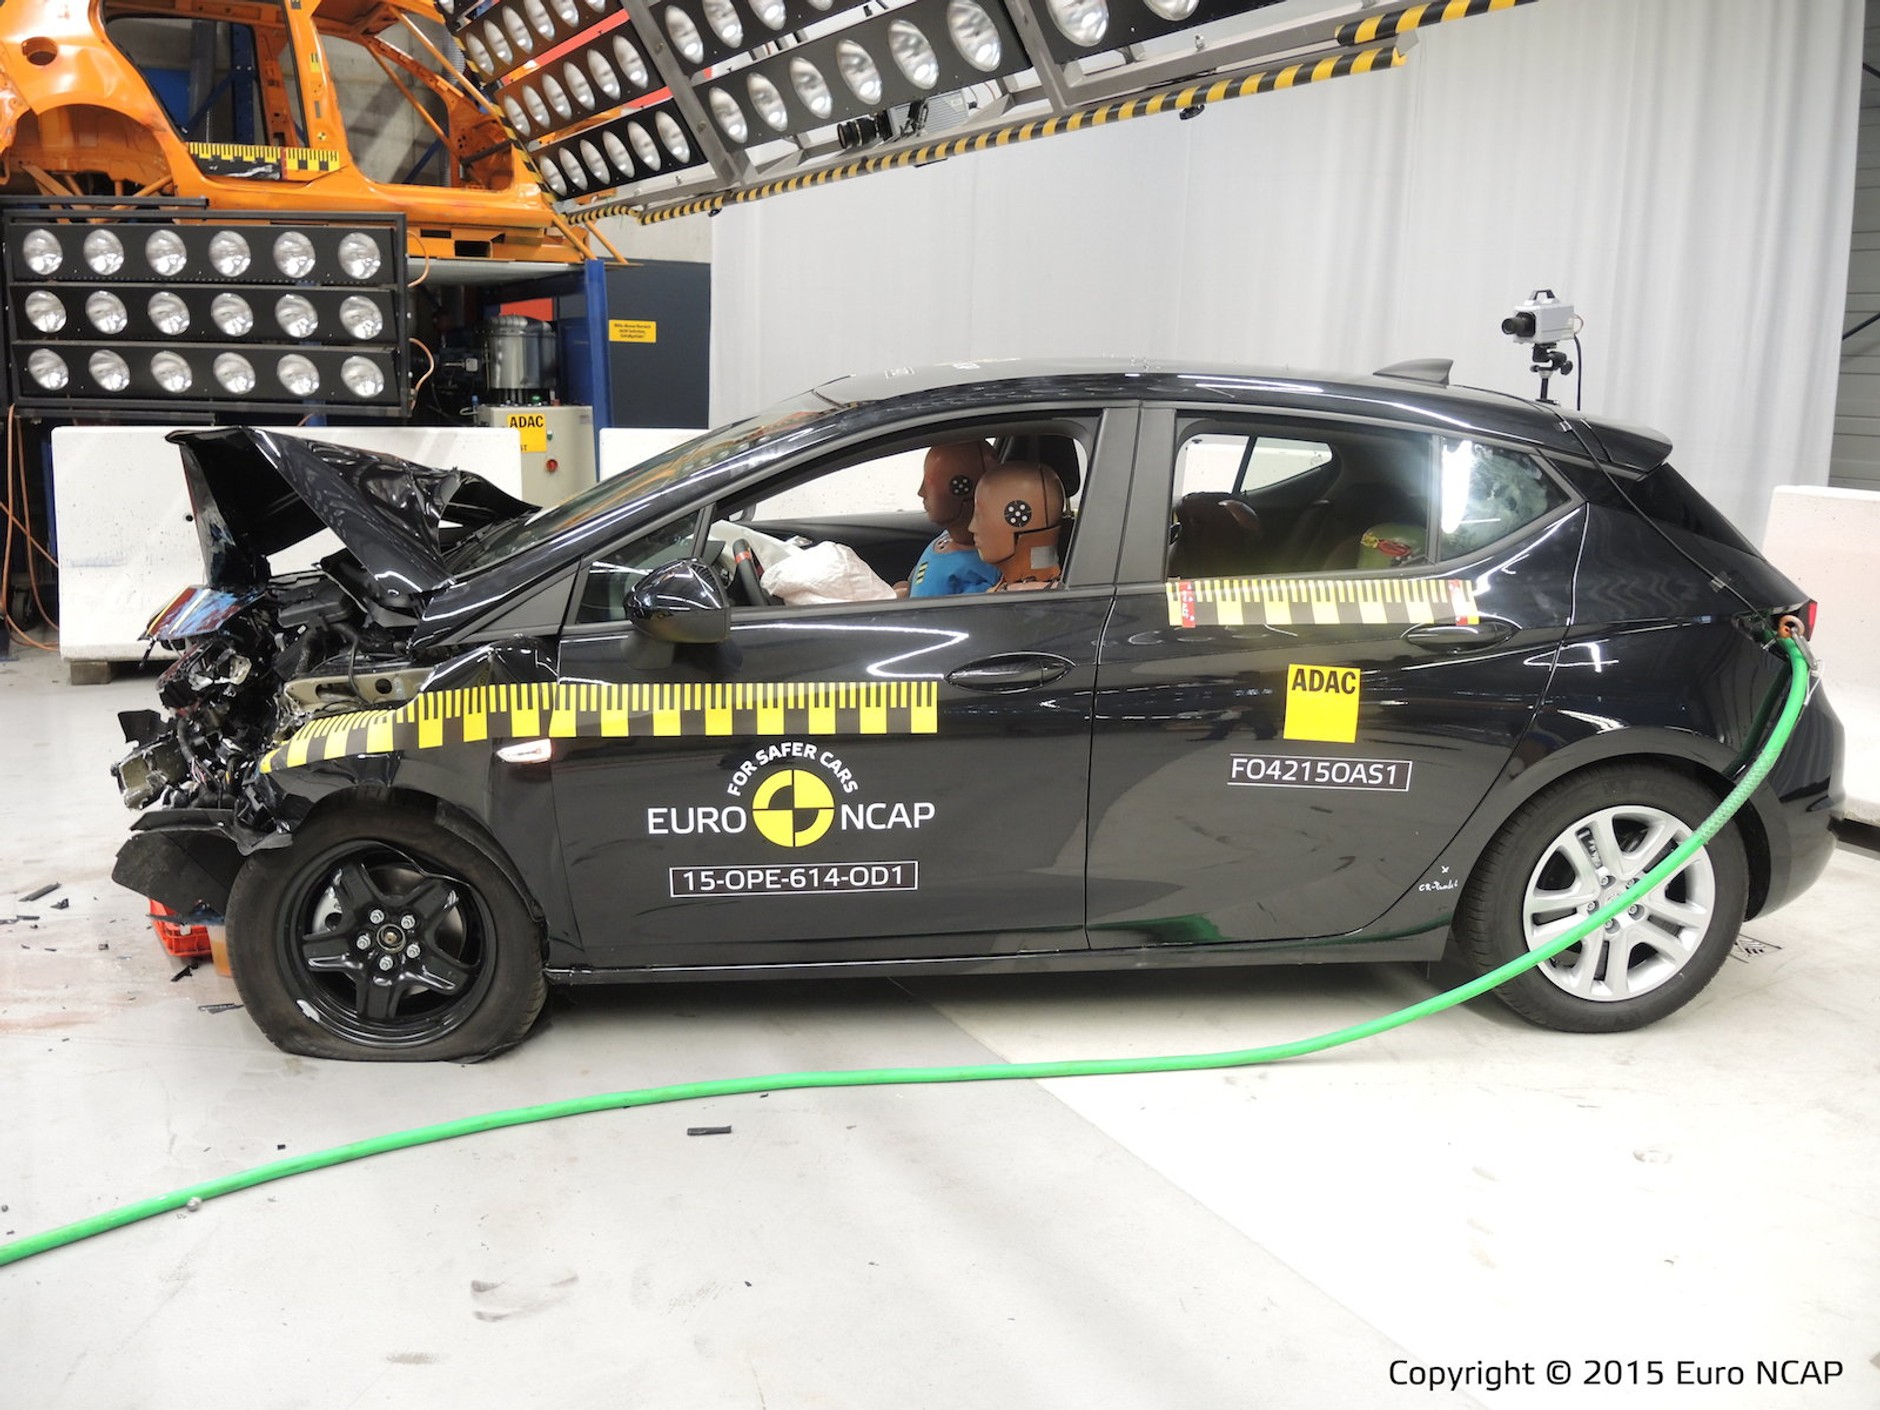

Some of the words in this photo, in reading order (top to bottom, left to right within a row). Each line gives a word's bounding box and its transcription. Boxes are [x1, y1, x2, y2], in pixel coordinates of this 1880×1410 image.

[509, 415, 544, 428] ADAC
[1291, 668, 1357, 695] ADAC
[726, 760, 758, 797] FOR
[755, 742, 818, 766] SAFER
[819, 751, 859, 795] CARS
[647, 806, 747, 835] EURO
[840, 801, 936, 831] NCAP
[683, 865, 903, 892] 15-OPE-614-OD1
